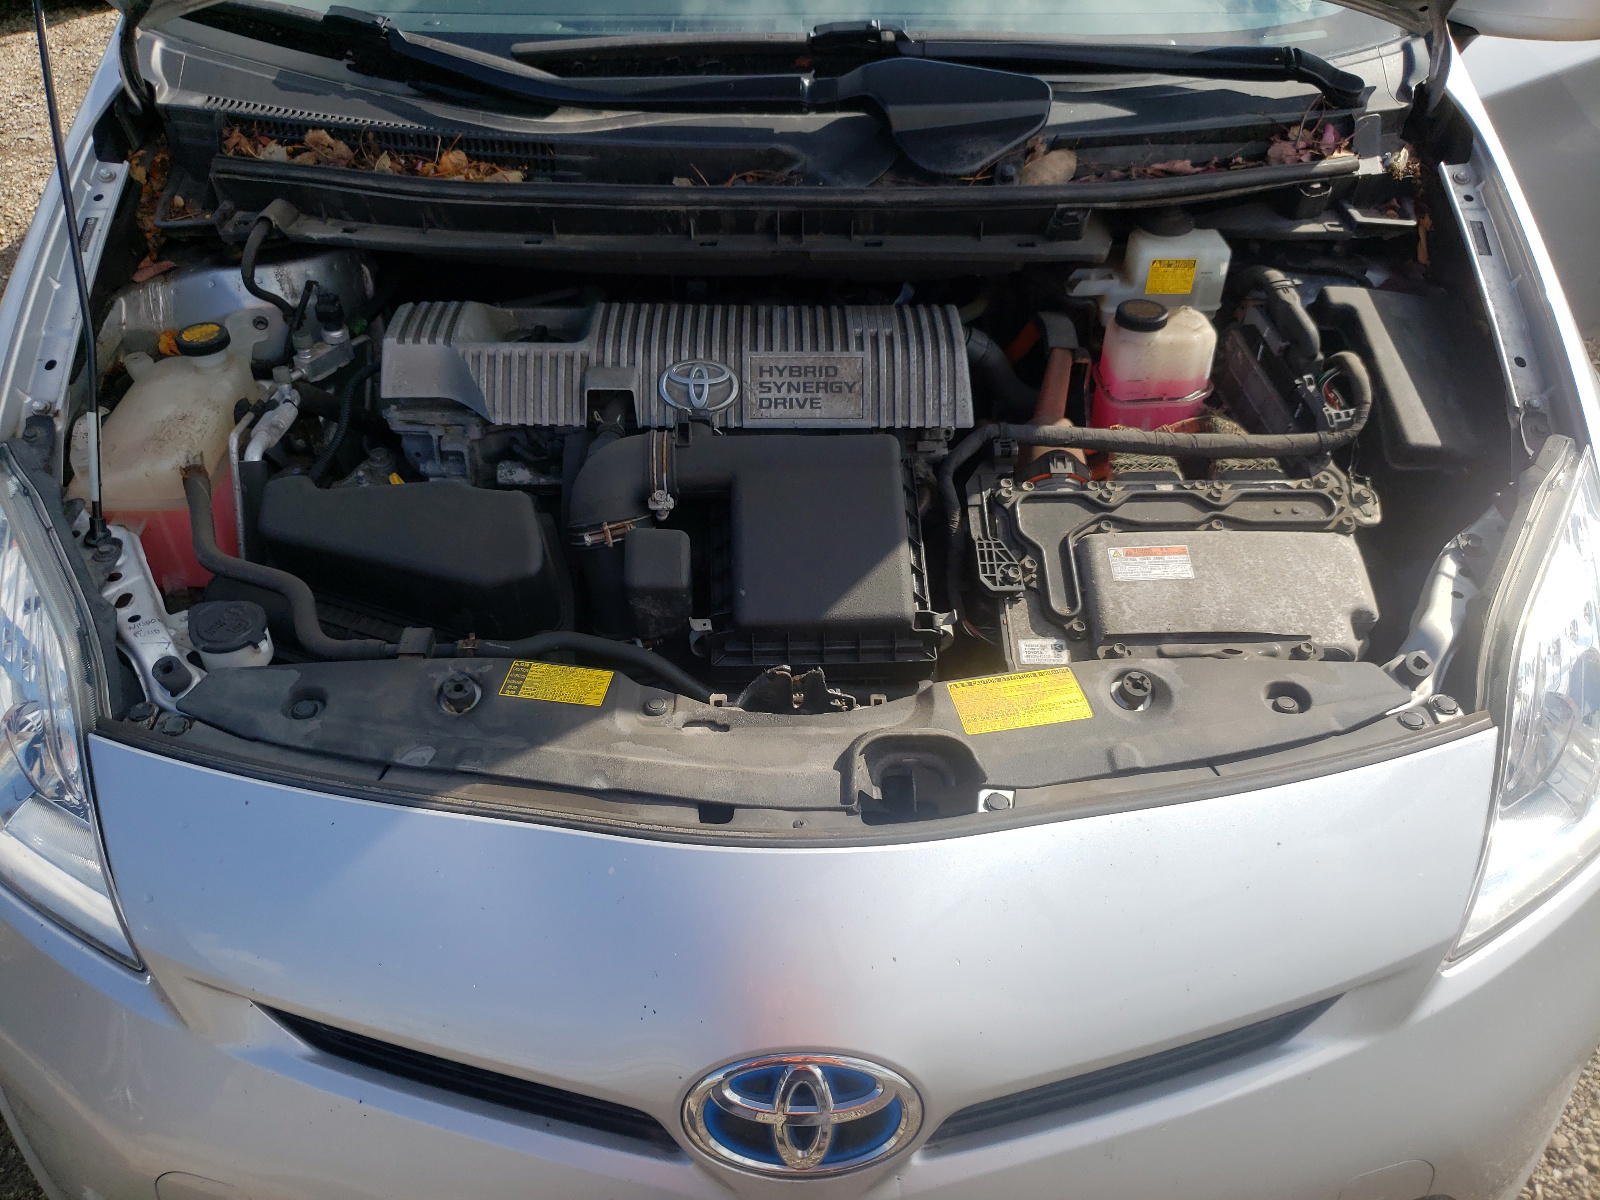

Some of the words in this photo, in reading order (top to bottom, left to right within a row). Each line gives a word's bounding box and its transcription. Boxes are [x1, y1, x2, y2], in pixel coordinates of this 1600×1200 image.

[759, 365, 838, 377] HYBRID
[758, 381, 858, 394] SYNERGY
[758, 397, 822, 410] DRIVE
